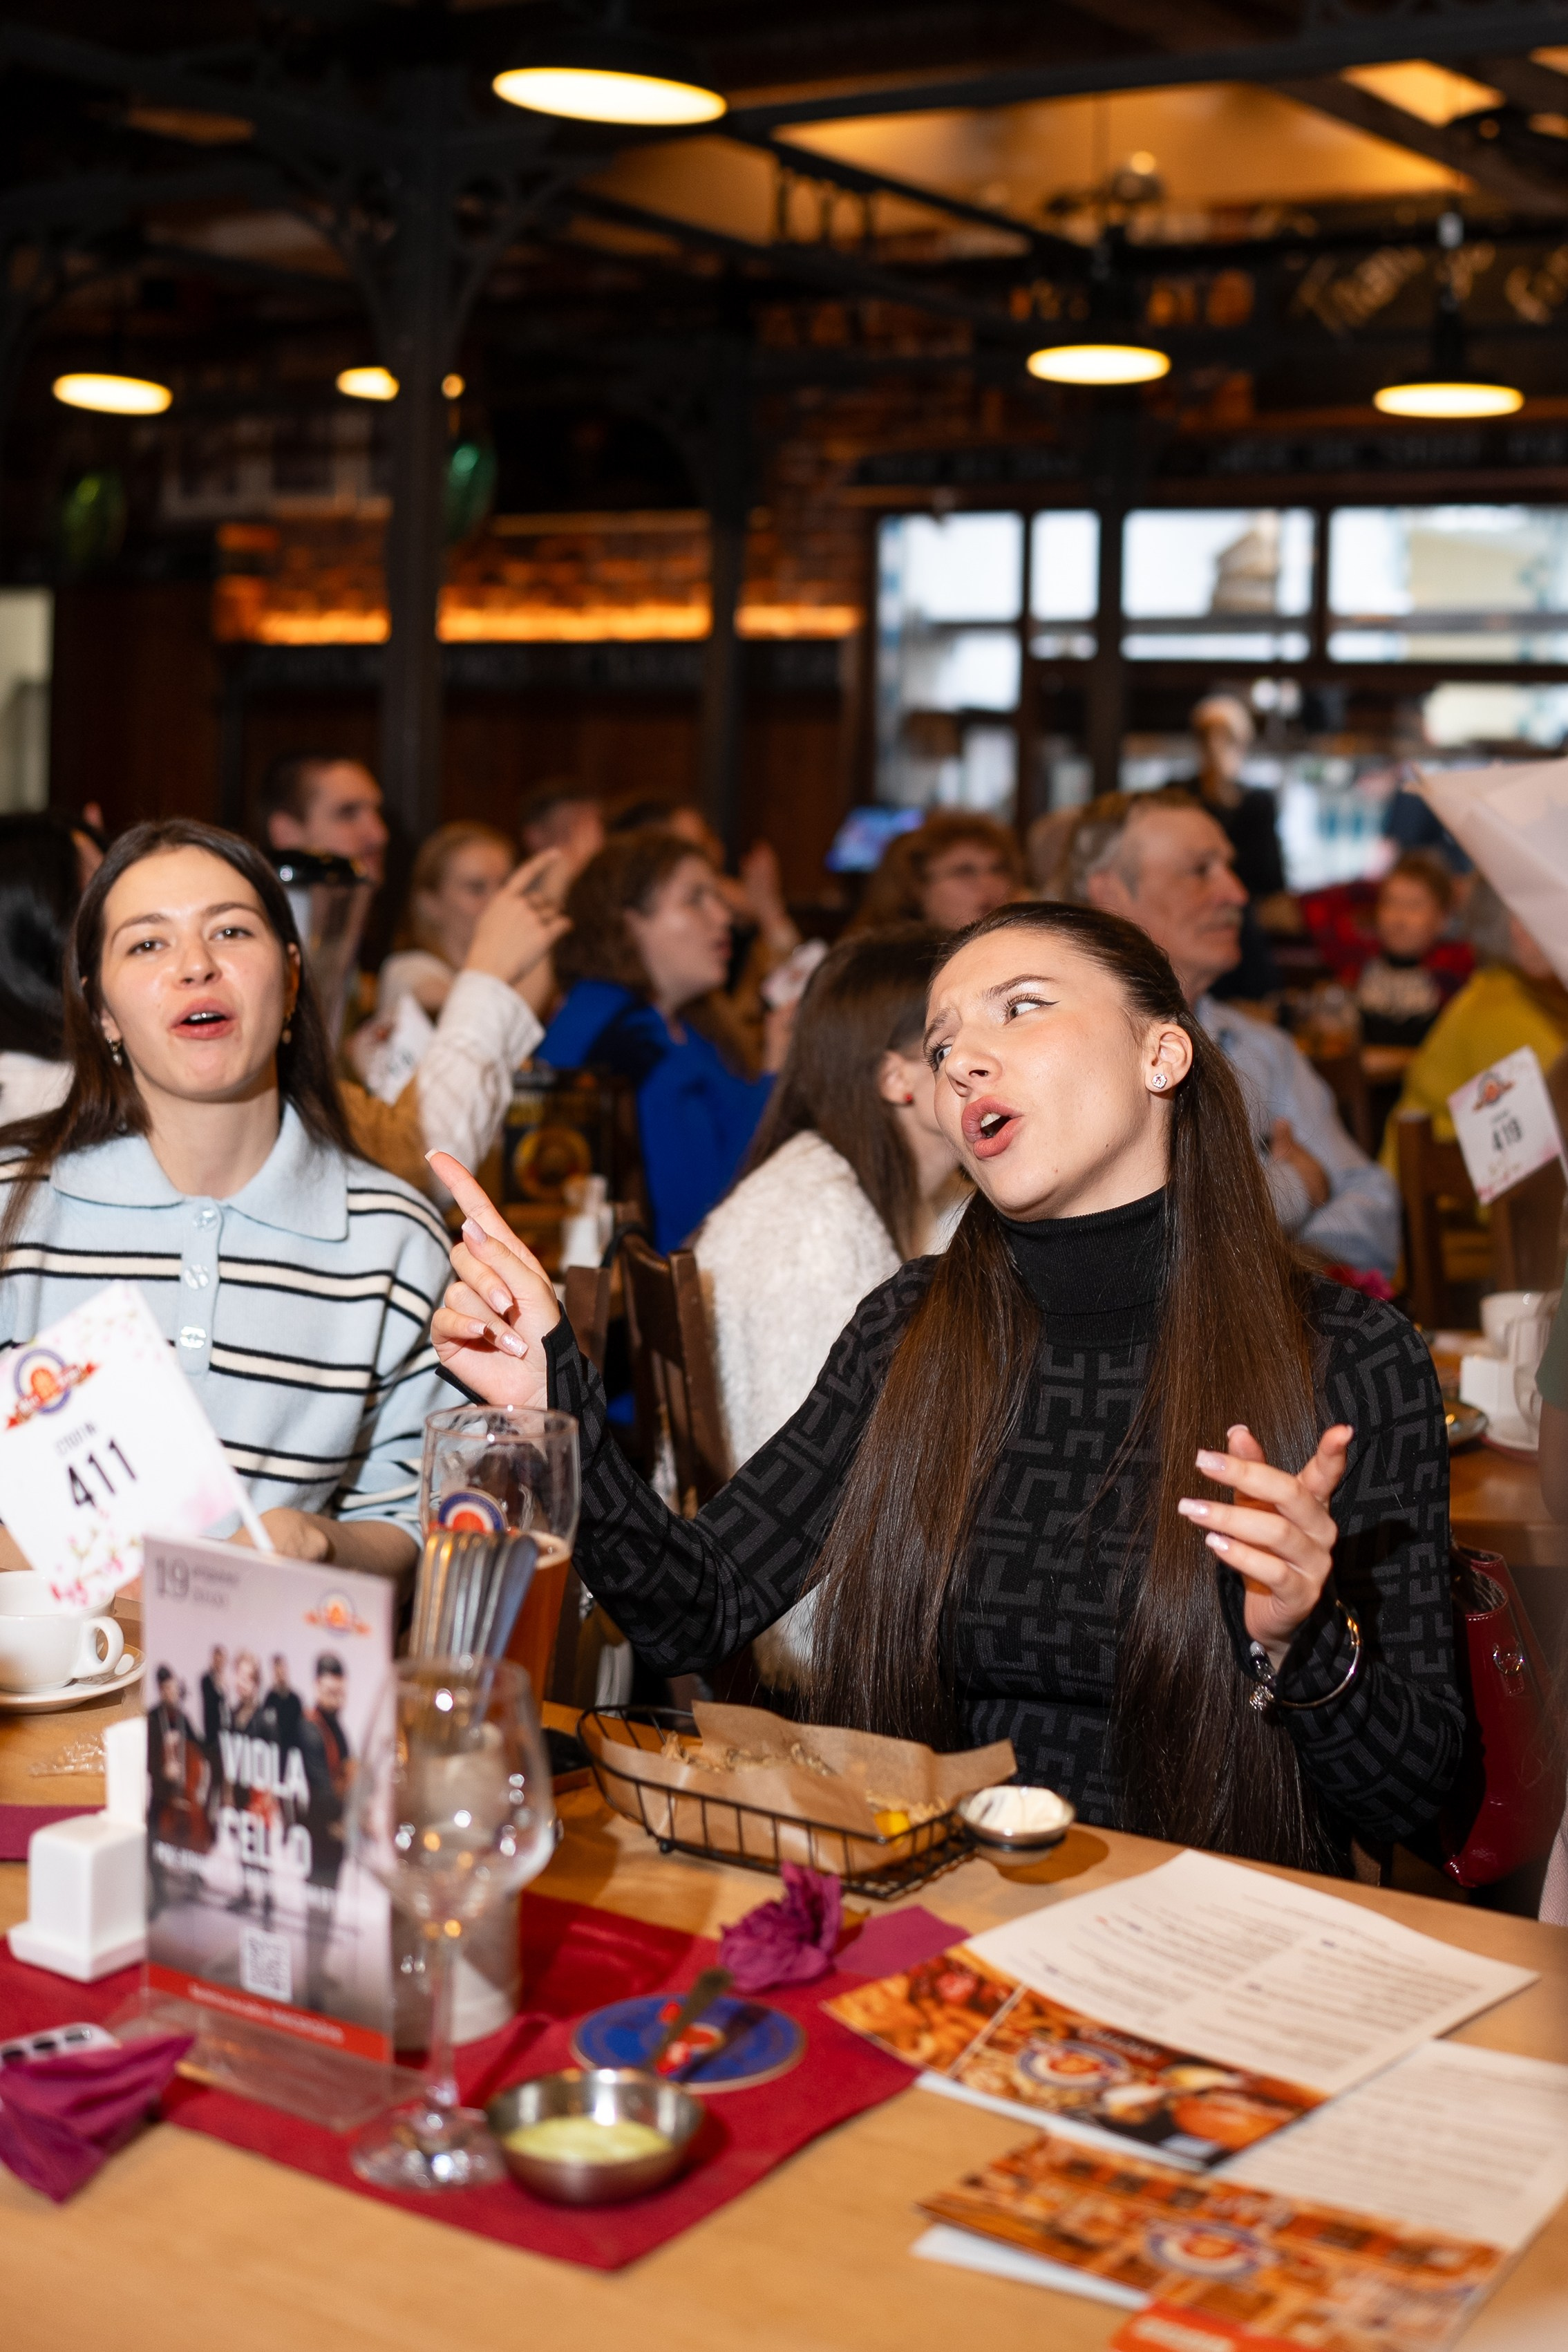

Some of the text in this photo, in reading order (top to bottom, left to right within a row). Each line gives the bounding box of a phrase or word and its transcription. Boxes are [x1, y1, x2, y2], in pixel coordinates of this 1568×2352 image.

[68, 1439, 137, 1508] 411
[155, 1556, 190, 1601] 19
[218, 1729, 310, 1809] VIOLA
